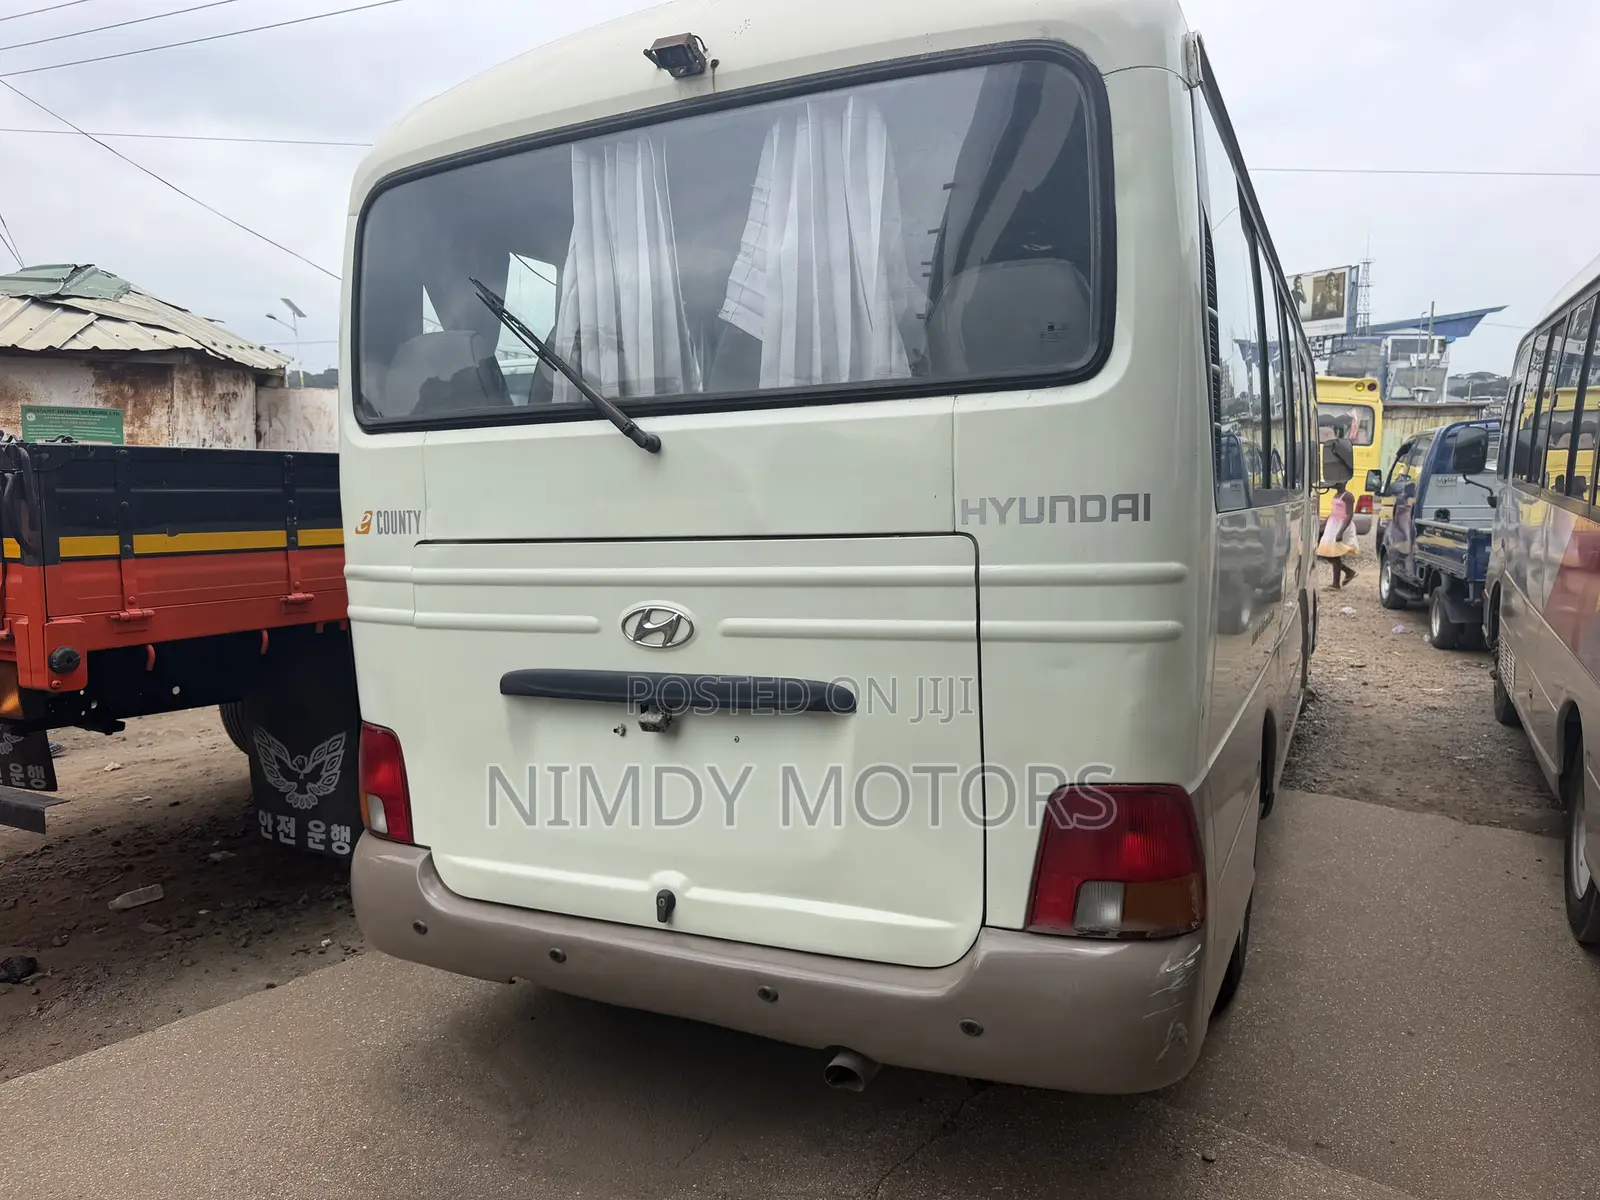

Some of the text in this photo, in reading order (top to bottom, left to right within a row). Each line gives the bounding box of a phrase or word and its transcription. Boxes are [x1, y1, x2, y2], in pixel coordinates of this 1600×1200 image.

[376, 510, 421, 535] COUNTY
[961, 493, 1151, 526] HYUNDAI
[9, 763, 48, 790] 운행
[258, 809, 352, 856] 안전 운행
